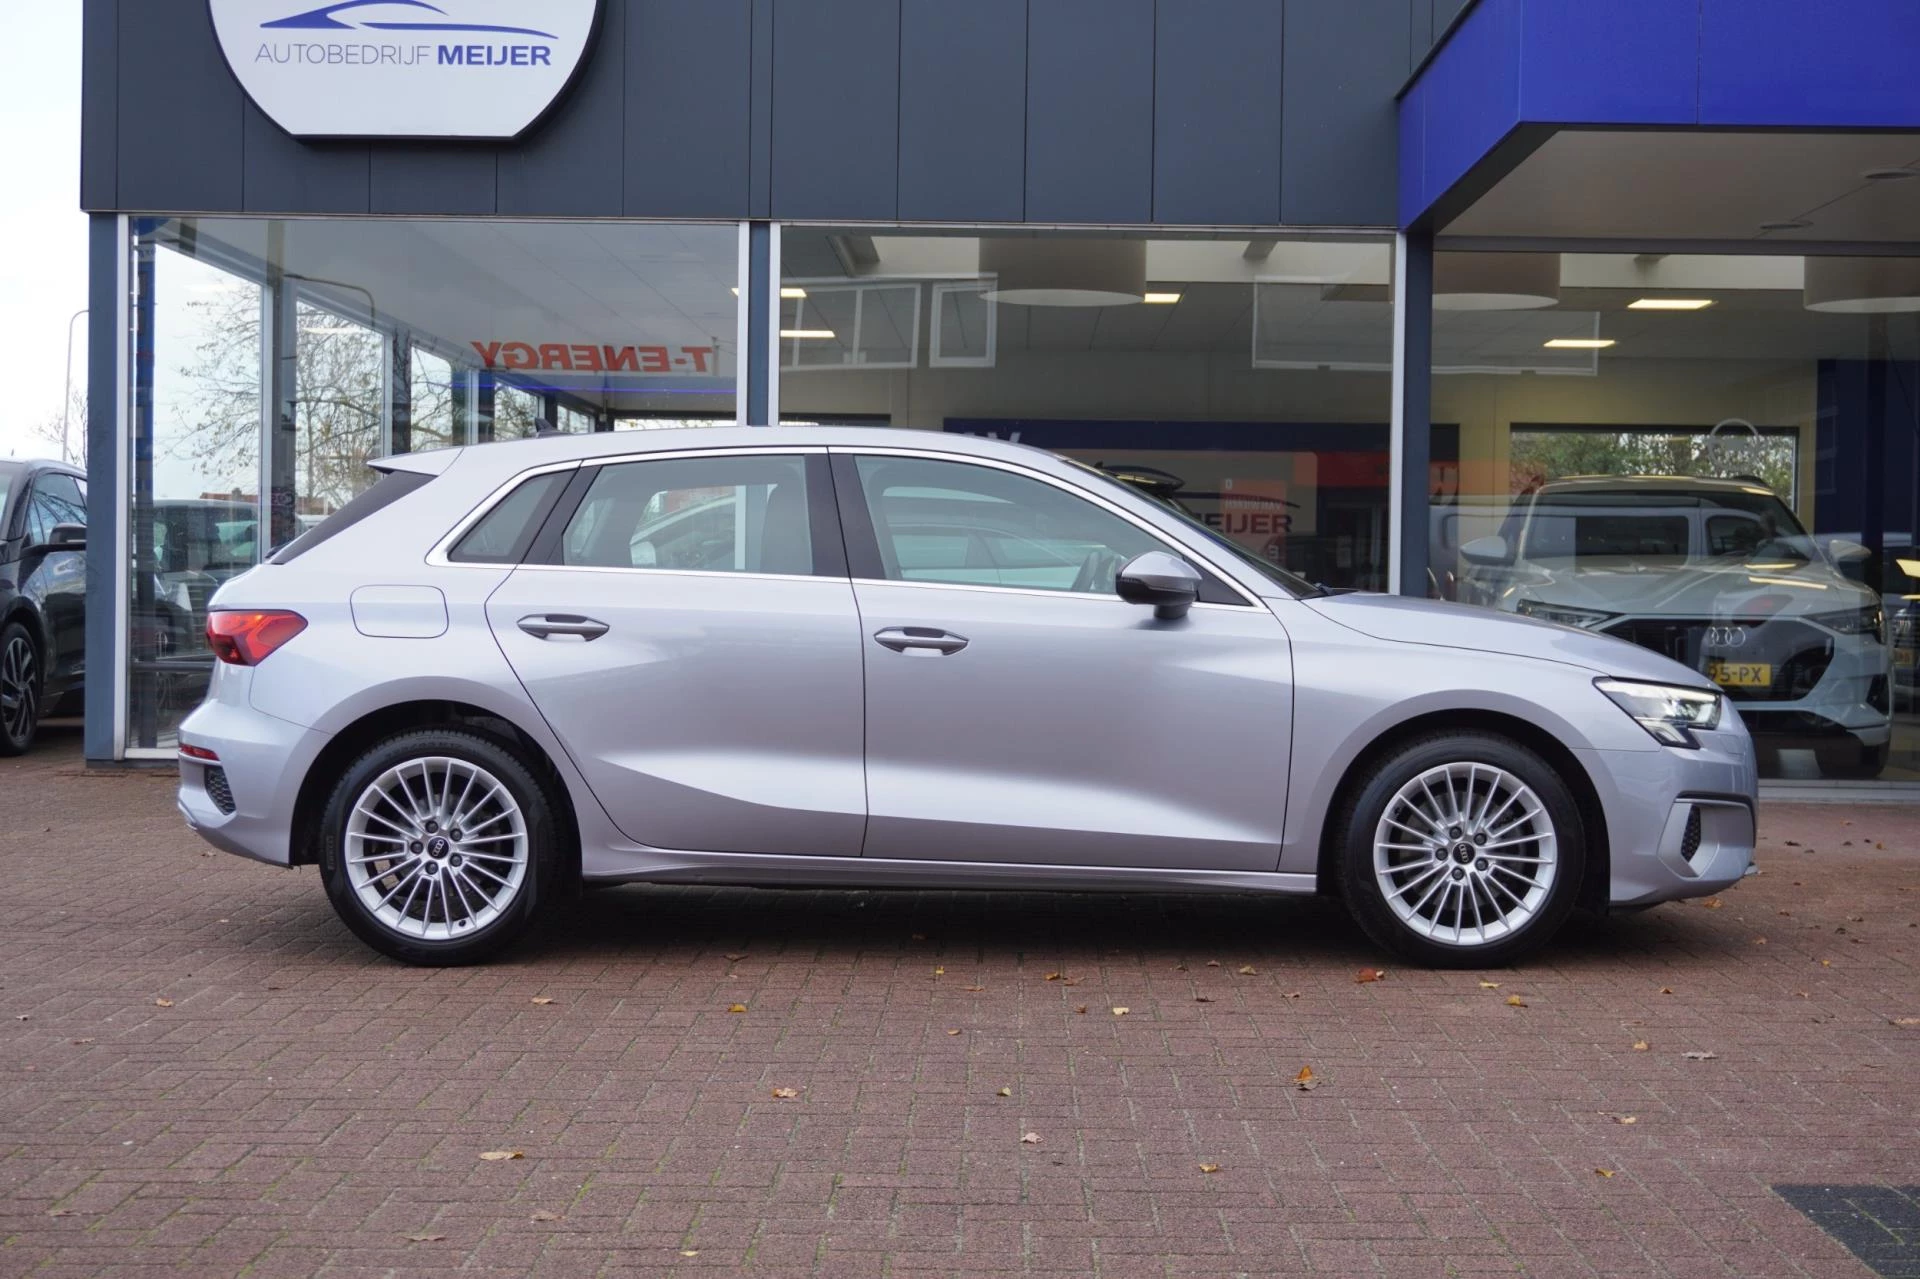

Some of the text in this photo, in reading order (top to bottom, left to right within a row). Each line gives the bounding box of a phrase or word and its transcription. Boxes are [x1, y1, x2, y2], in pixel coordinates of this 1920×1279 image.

[255, 43, 552, 66] AUTOBEDRIJF MEIJER
[1195, 512, 1293, 534] EIJER
